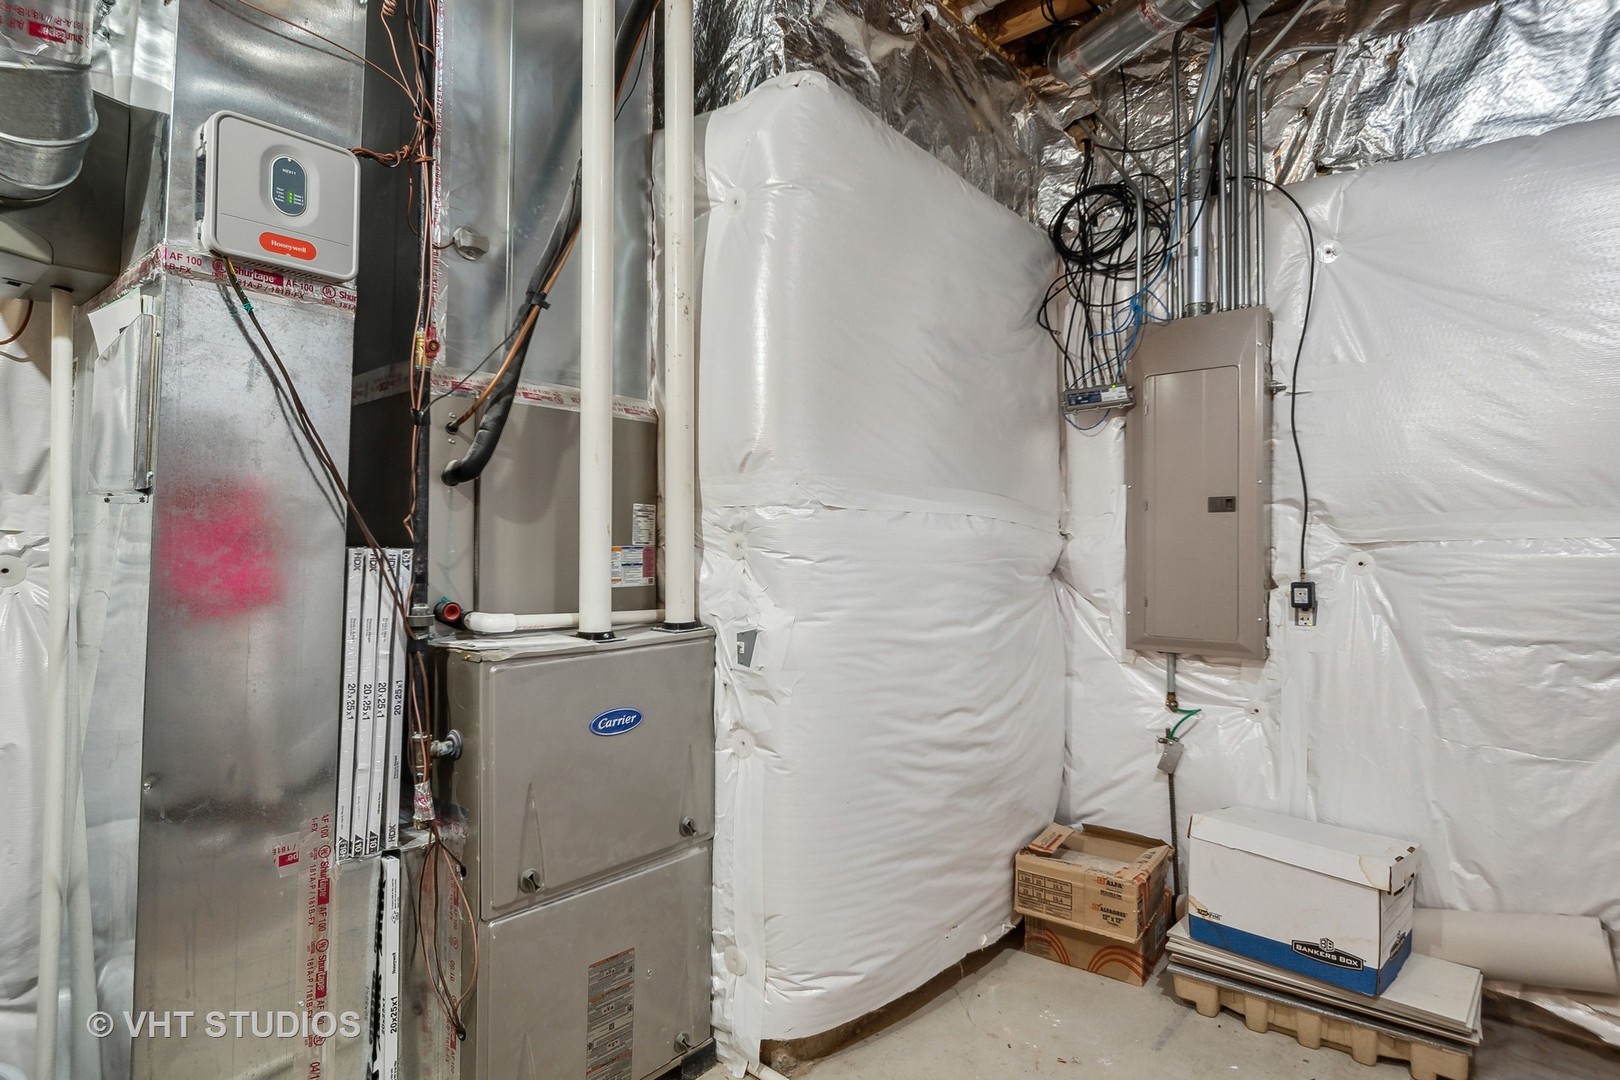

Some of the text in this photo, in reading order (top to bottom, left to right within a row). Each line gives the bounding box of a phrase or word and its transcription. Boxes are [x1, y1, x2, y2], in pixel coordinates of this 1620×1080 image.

[271, 239, 307, 253] Honeywell
[170, 252, 183, 261] AF
[186, 256, 202, 267] 100
[234, 266, 275, 284] Shurtape
[286, 279, 297, 287] AF
[300, 283, 314, 293] 100
[353, 552, 362, 571] HDX
[369, 553, 378, 572] HDX
[362, 683, 373, 720] 20x25x1
[376, 682, 387, 718] 20x25x1
[393, 679, 403, 716] 20x25x1
[598, 714, 638, 730] Carrier
[321, 825, 329, 839] 100
[388, 823, 397, 842] HDX
[354, 842, 363, 852] 10
[369, 839, 377, 848] 10
[308, 864, 317, 890] 181A-P
[318, 861, 329, 897] Shurtape
[1106, 880, 1123, 889] ALFA
[307, 896, 316, 927] 181B-FX
[319, 907, 327, 917] AF
[318, 919, 327, 932] 100
[1295, 943, 1359, 967] BANKERS BOX
[306, 957, 314, 983] 181A-P
[316, 954, 327, 991] Shurtape
[316, 1000, 324, 1010] AF
[390, 996, 398, 1034] 20x25x1
